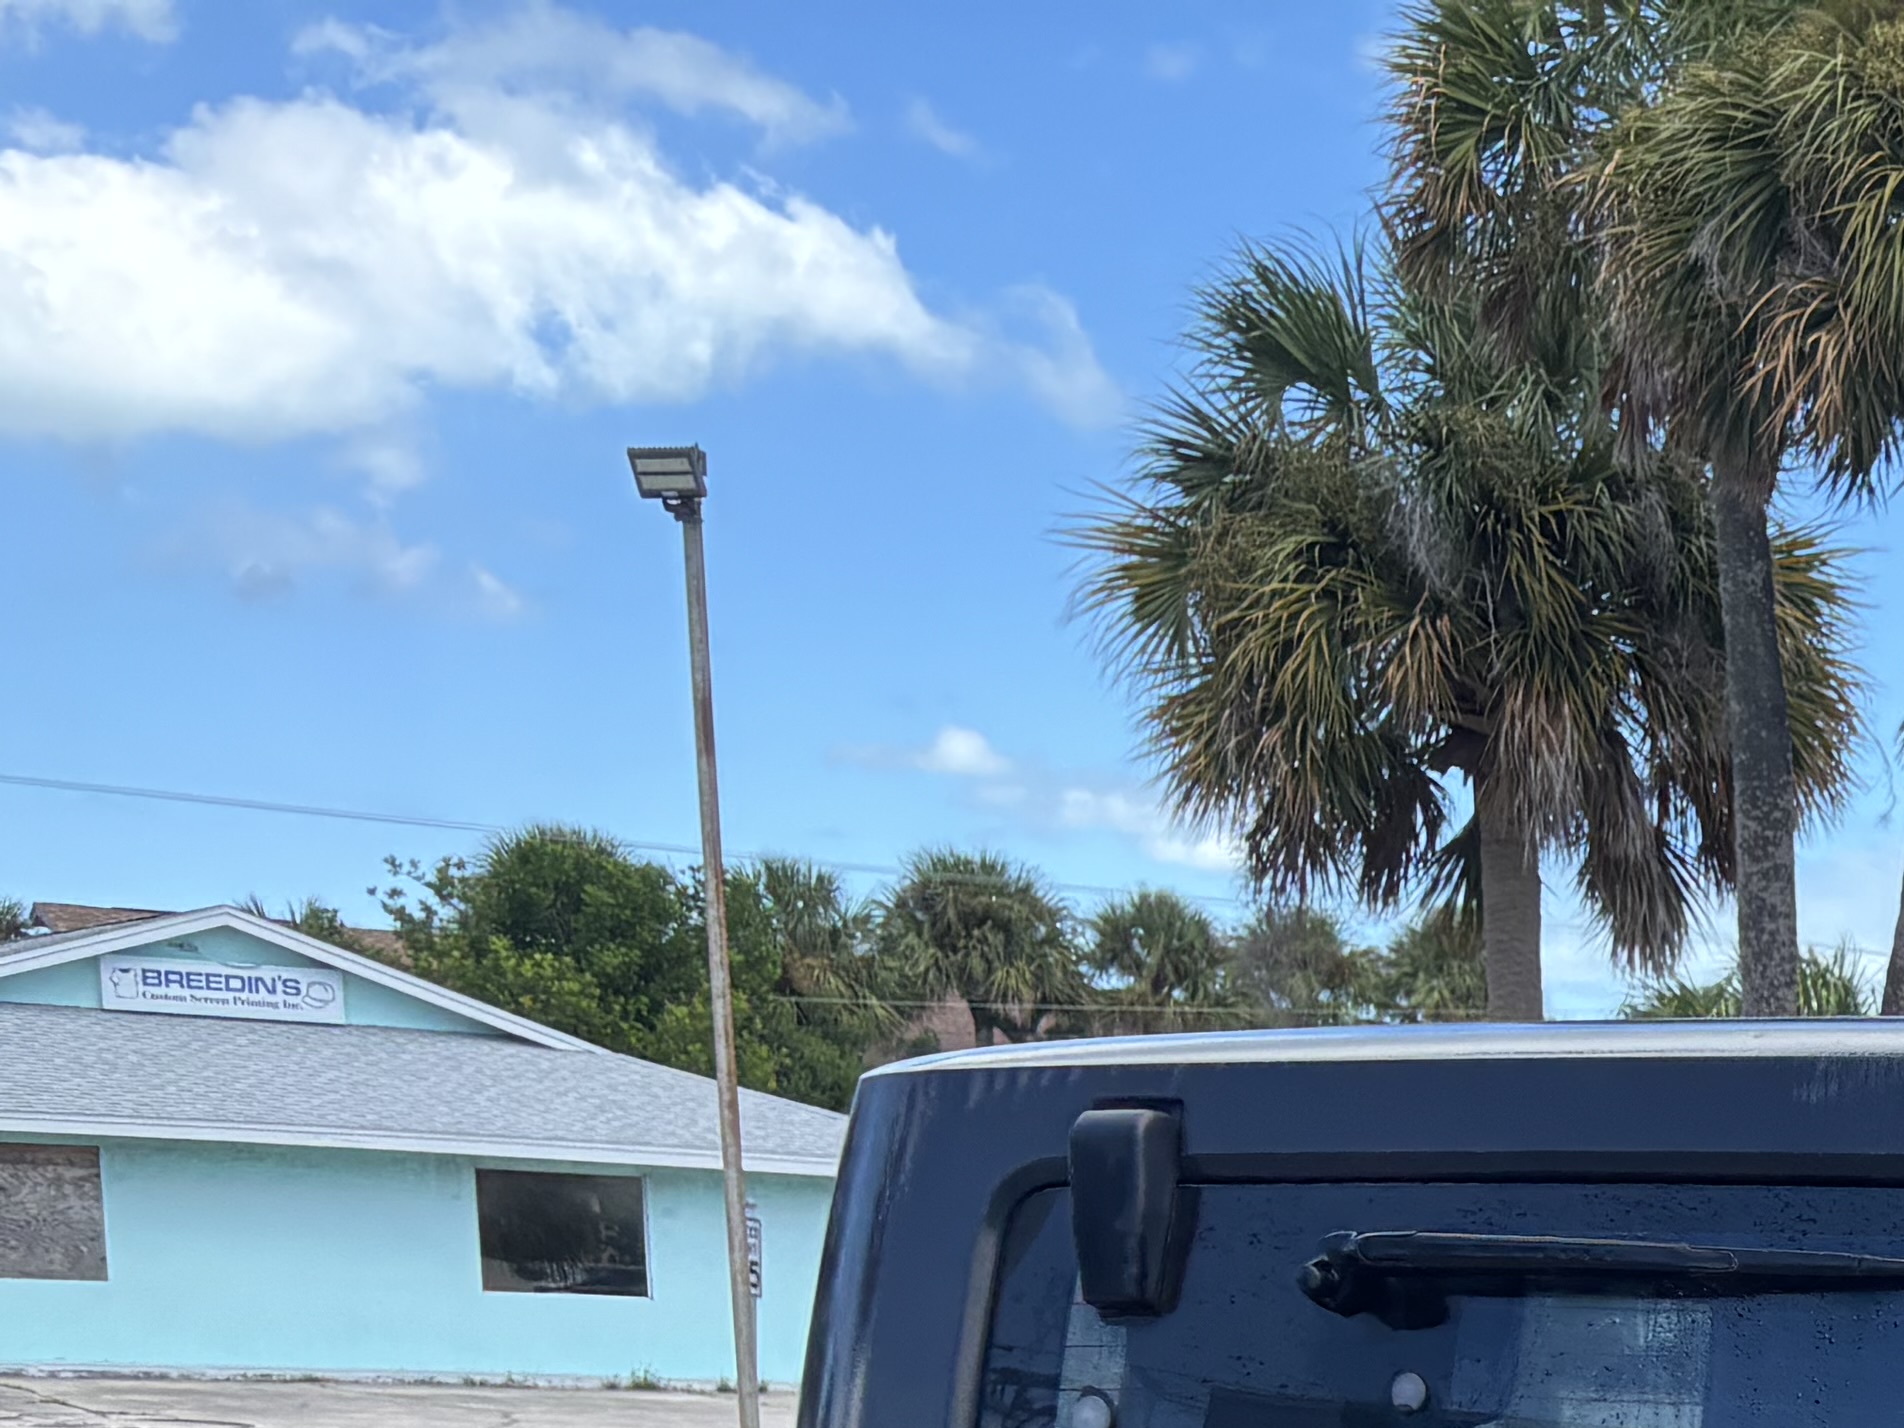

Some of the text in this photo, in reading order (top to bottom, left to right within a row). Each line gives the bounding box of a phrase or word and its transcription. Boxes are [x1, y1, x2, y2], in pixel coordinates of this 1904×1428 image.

[141, 967, 302, 997] BREEDIN'S
[142, 991, 188, 1003] Custom
[190, 993, 230, 1007] Screen
[233, 997, 280, 1010] Printing
